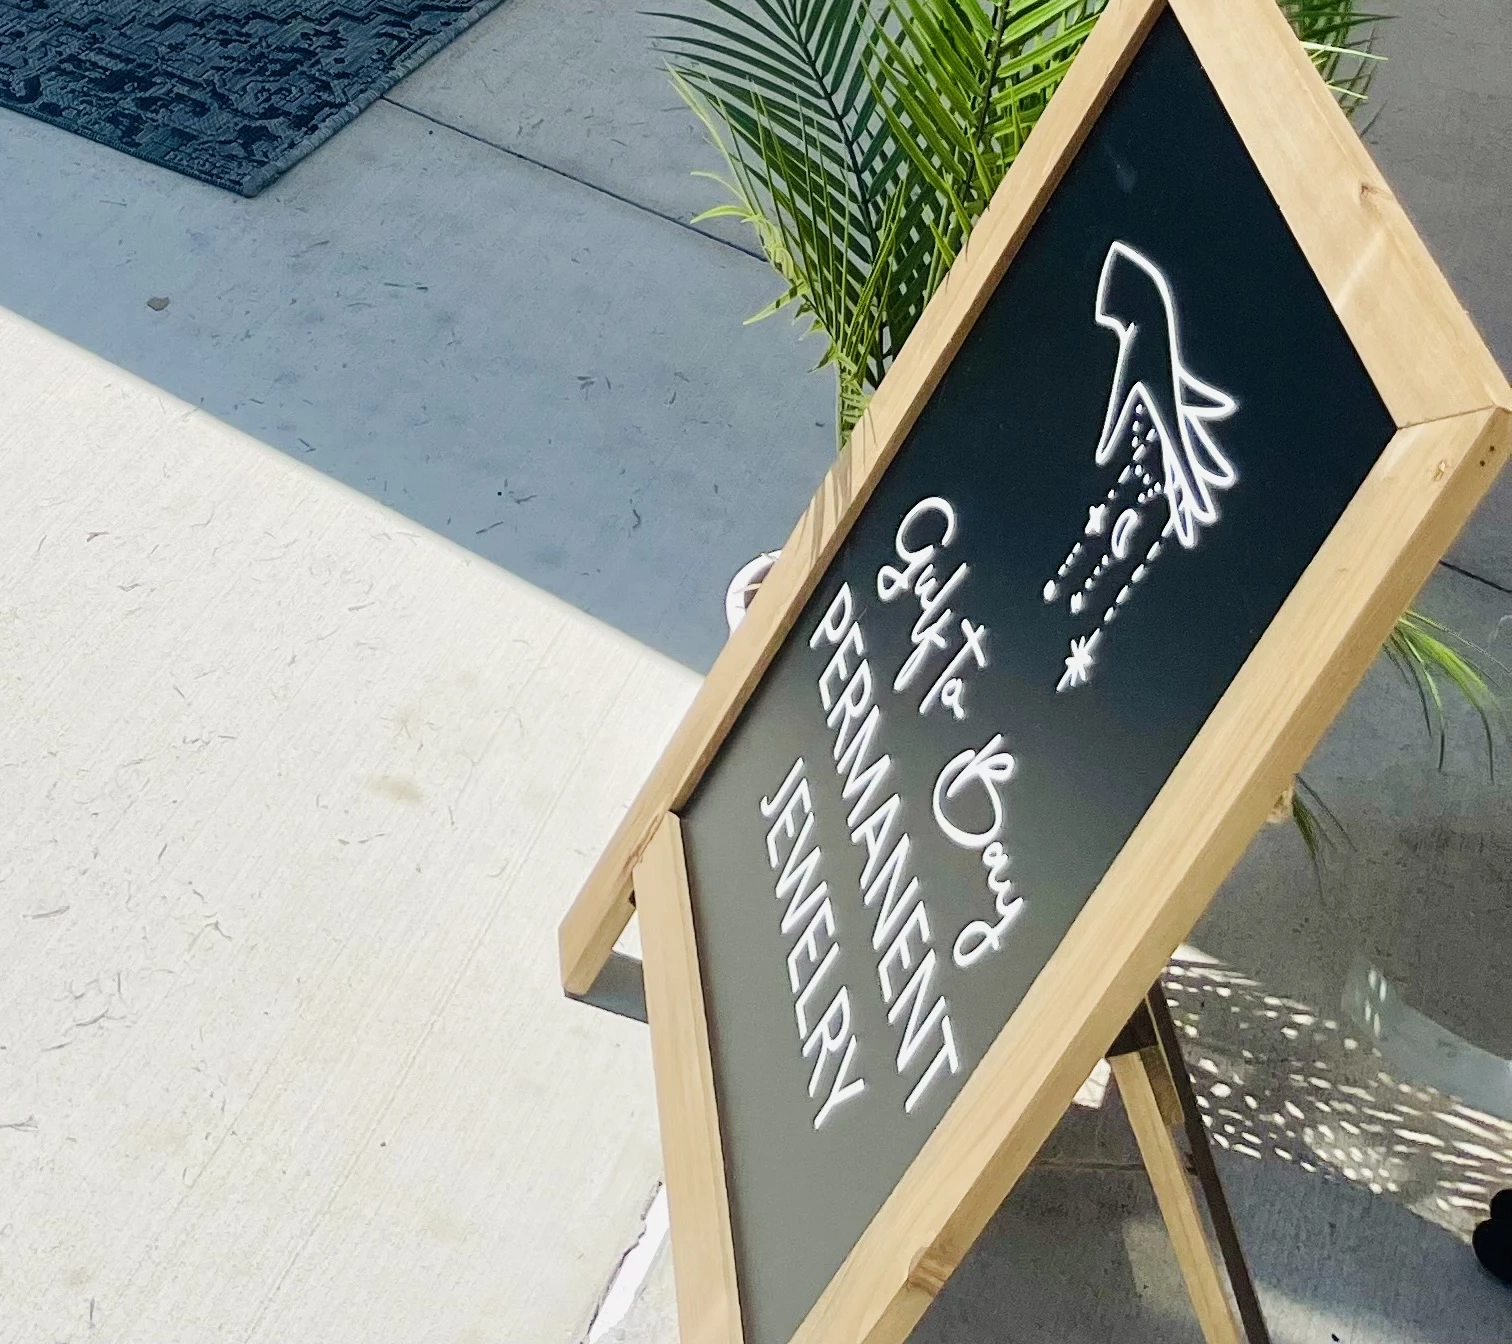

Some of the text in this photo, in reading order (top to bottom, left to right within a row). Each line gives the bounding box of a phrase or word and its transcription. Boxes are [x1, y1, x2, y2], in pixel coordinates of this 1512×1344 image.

[762, 757, 866, 1130] JEWELRY
[809, 581, 960, 1113] PERMANENT
[878, 497, 967, 691] Gulf
[933, 734, 1024, 967] Bay
